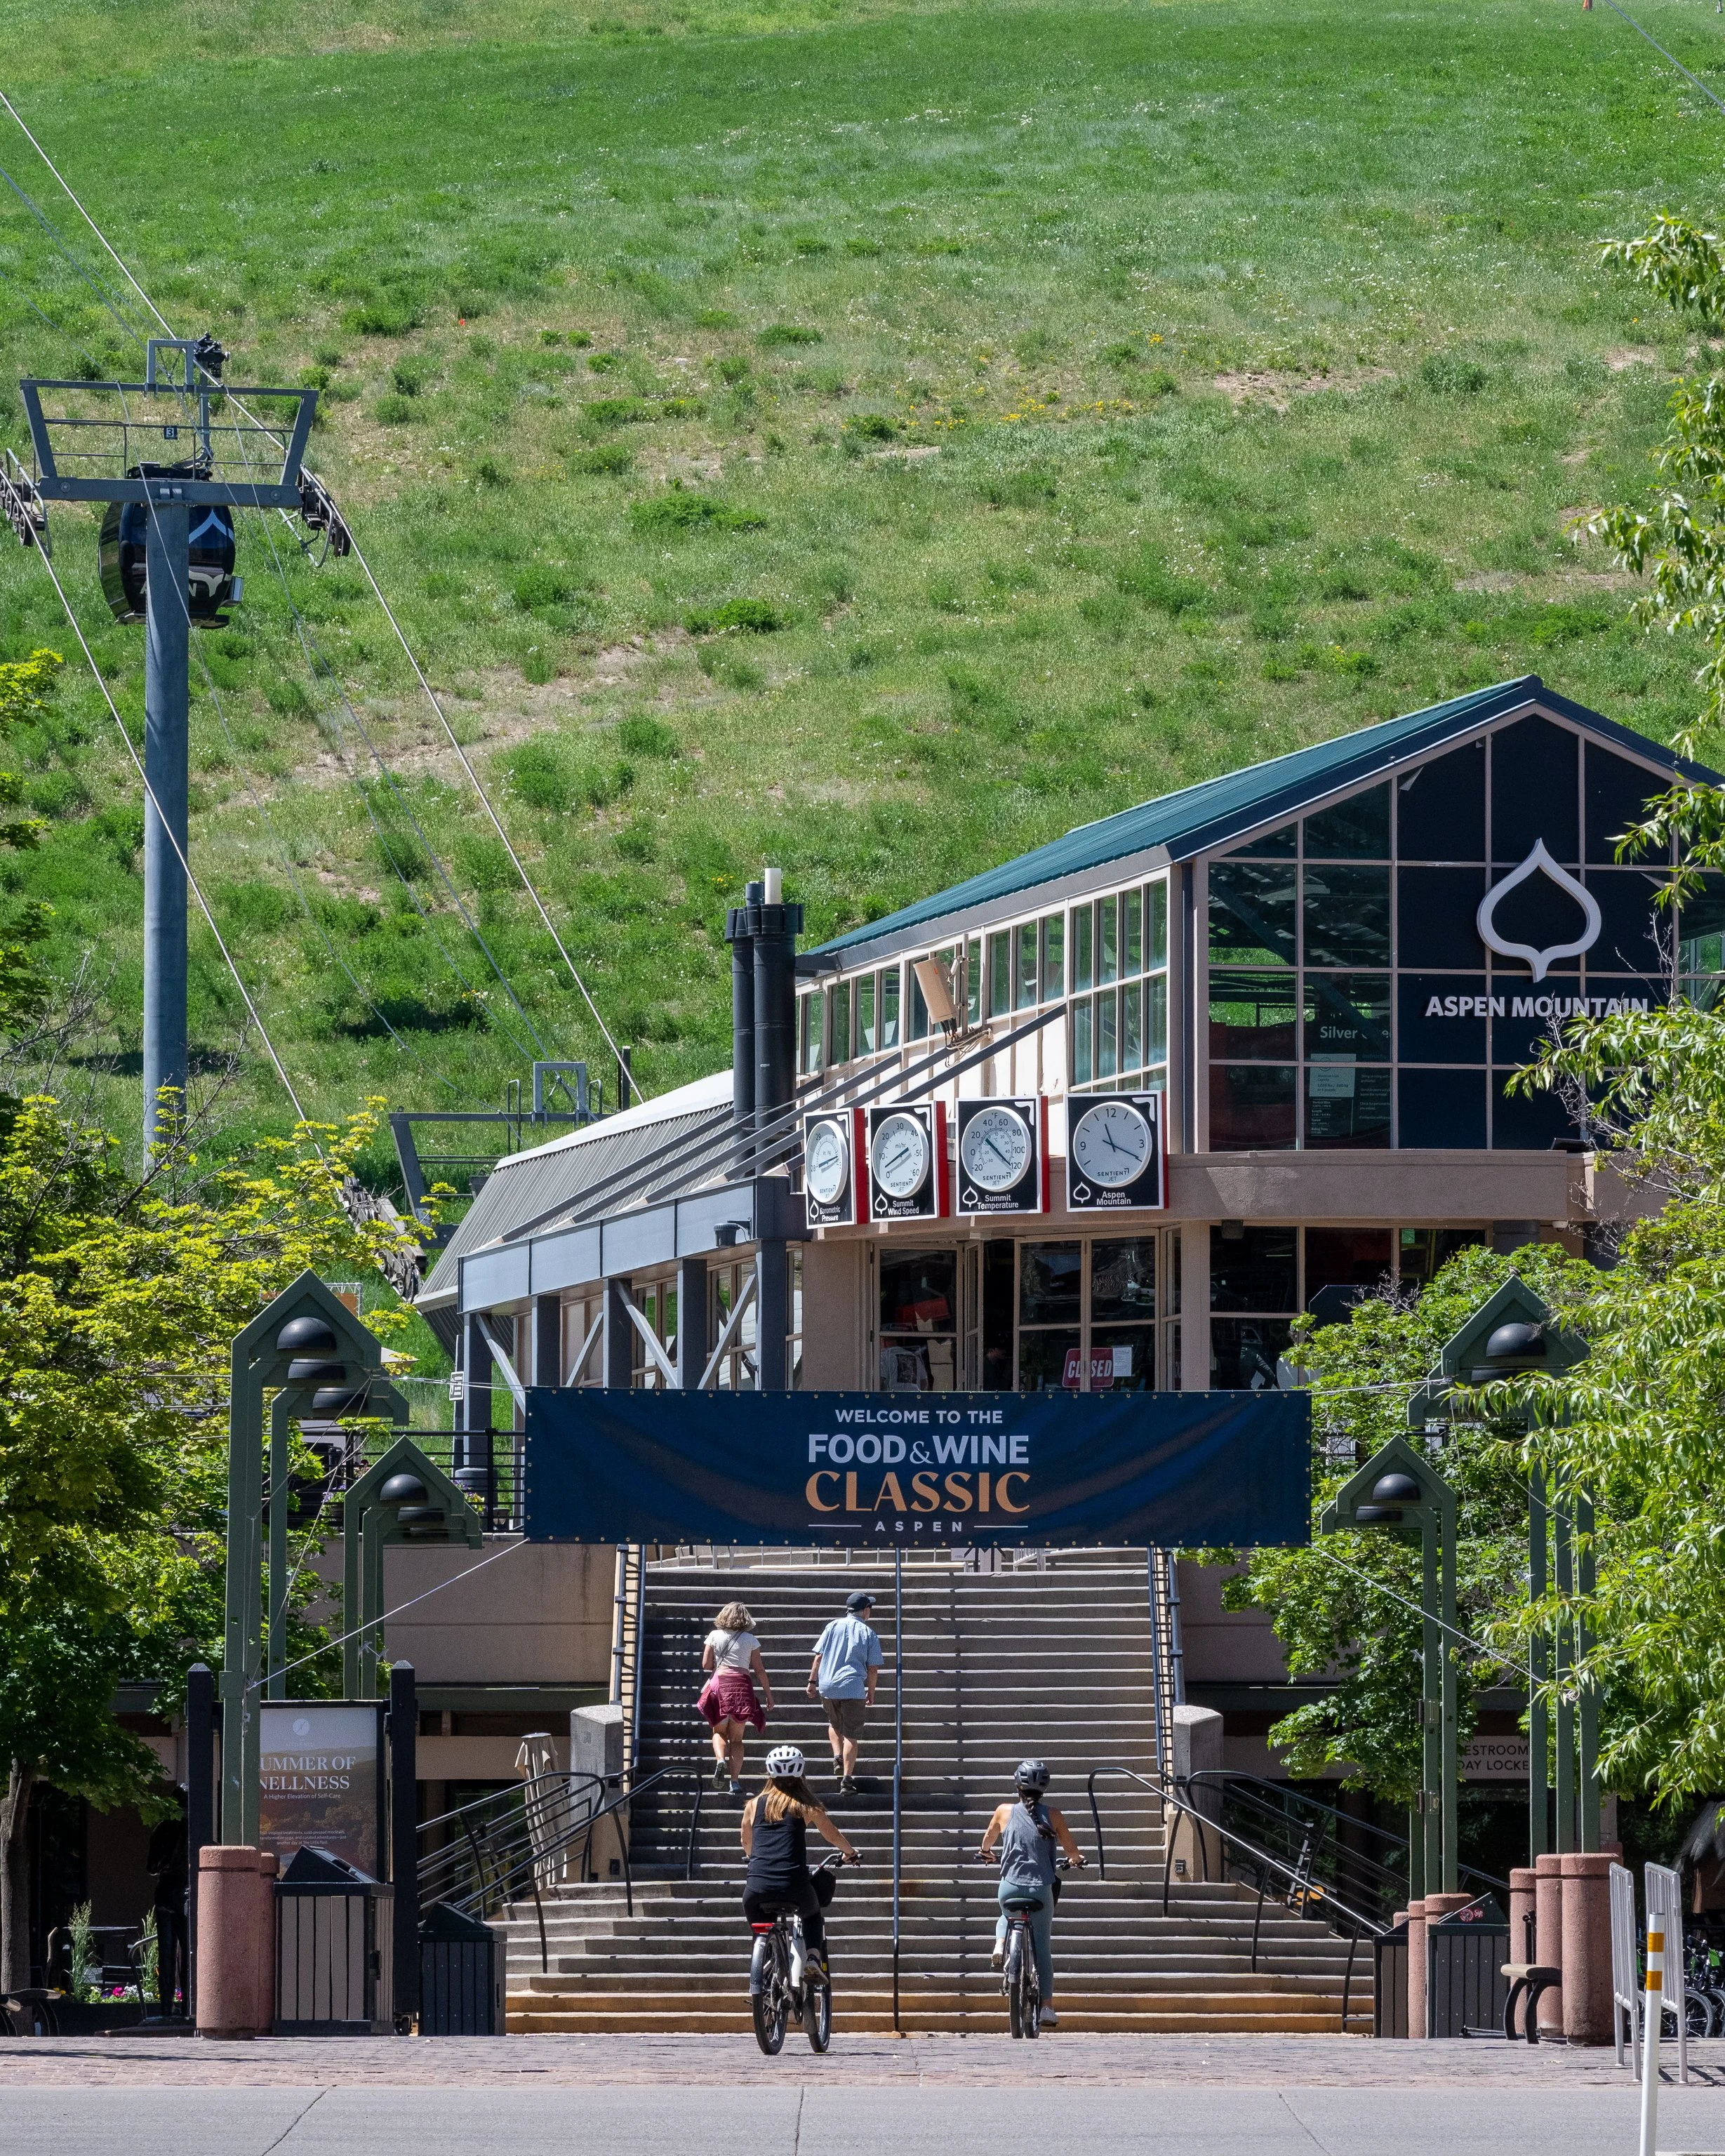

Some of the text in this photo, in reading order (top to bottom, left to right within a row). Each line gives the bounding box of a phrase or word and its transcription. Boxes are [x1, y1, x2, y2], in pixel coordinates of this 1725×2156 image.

[1425, 996, 1649, 1020] ASPEN MOUNTAIN
[1320, 1026, 1358, 1039] Silver
[1105, 1108, 1117, 1118] 12
[1080, 1141, 1086, 1150] 9
[1139, 1139, 1145, 1148] 3
[1102, 1191, 1125, 1199] Aspen
[892, 1199, 914, 1208] Summit
[977, 1202, 1019, 1211] Temperature
[820, 1206, 841, 1215] Barometric
[902, 1206, 919, 1215] Speed
[1067, 1360, 1112, 1378] CLSED
[835, 1409, 1003, 1424] WELCOME TO THE
[806, 1470, 1031, 1512] CLASSIC
[875, 1521, 962, 1532] ASPEN
[1465, 1745, 1528, 1755] ESTROOM
[260, 1756, 357, 1771] UMMER OF
[1487, 1760, 1528, 1771] LOCKE
